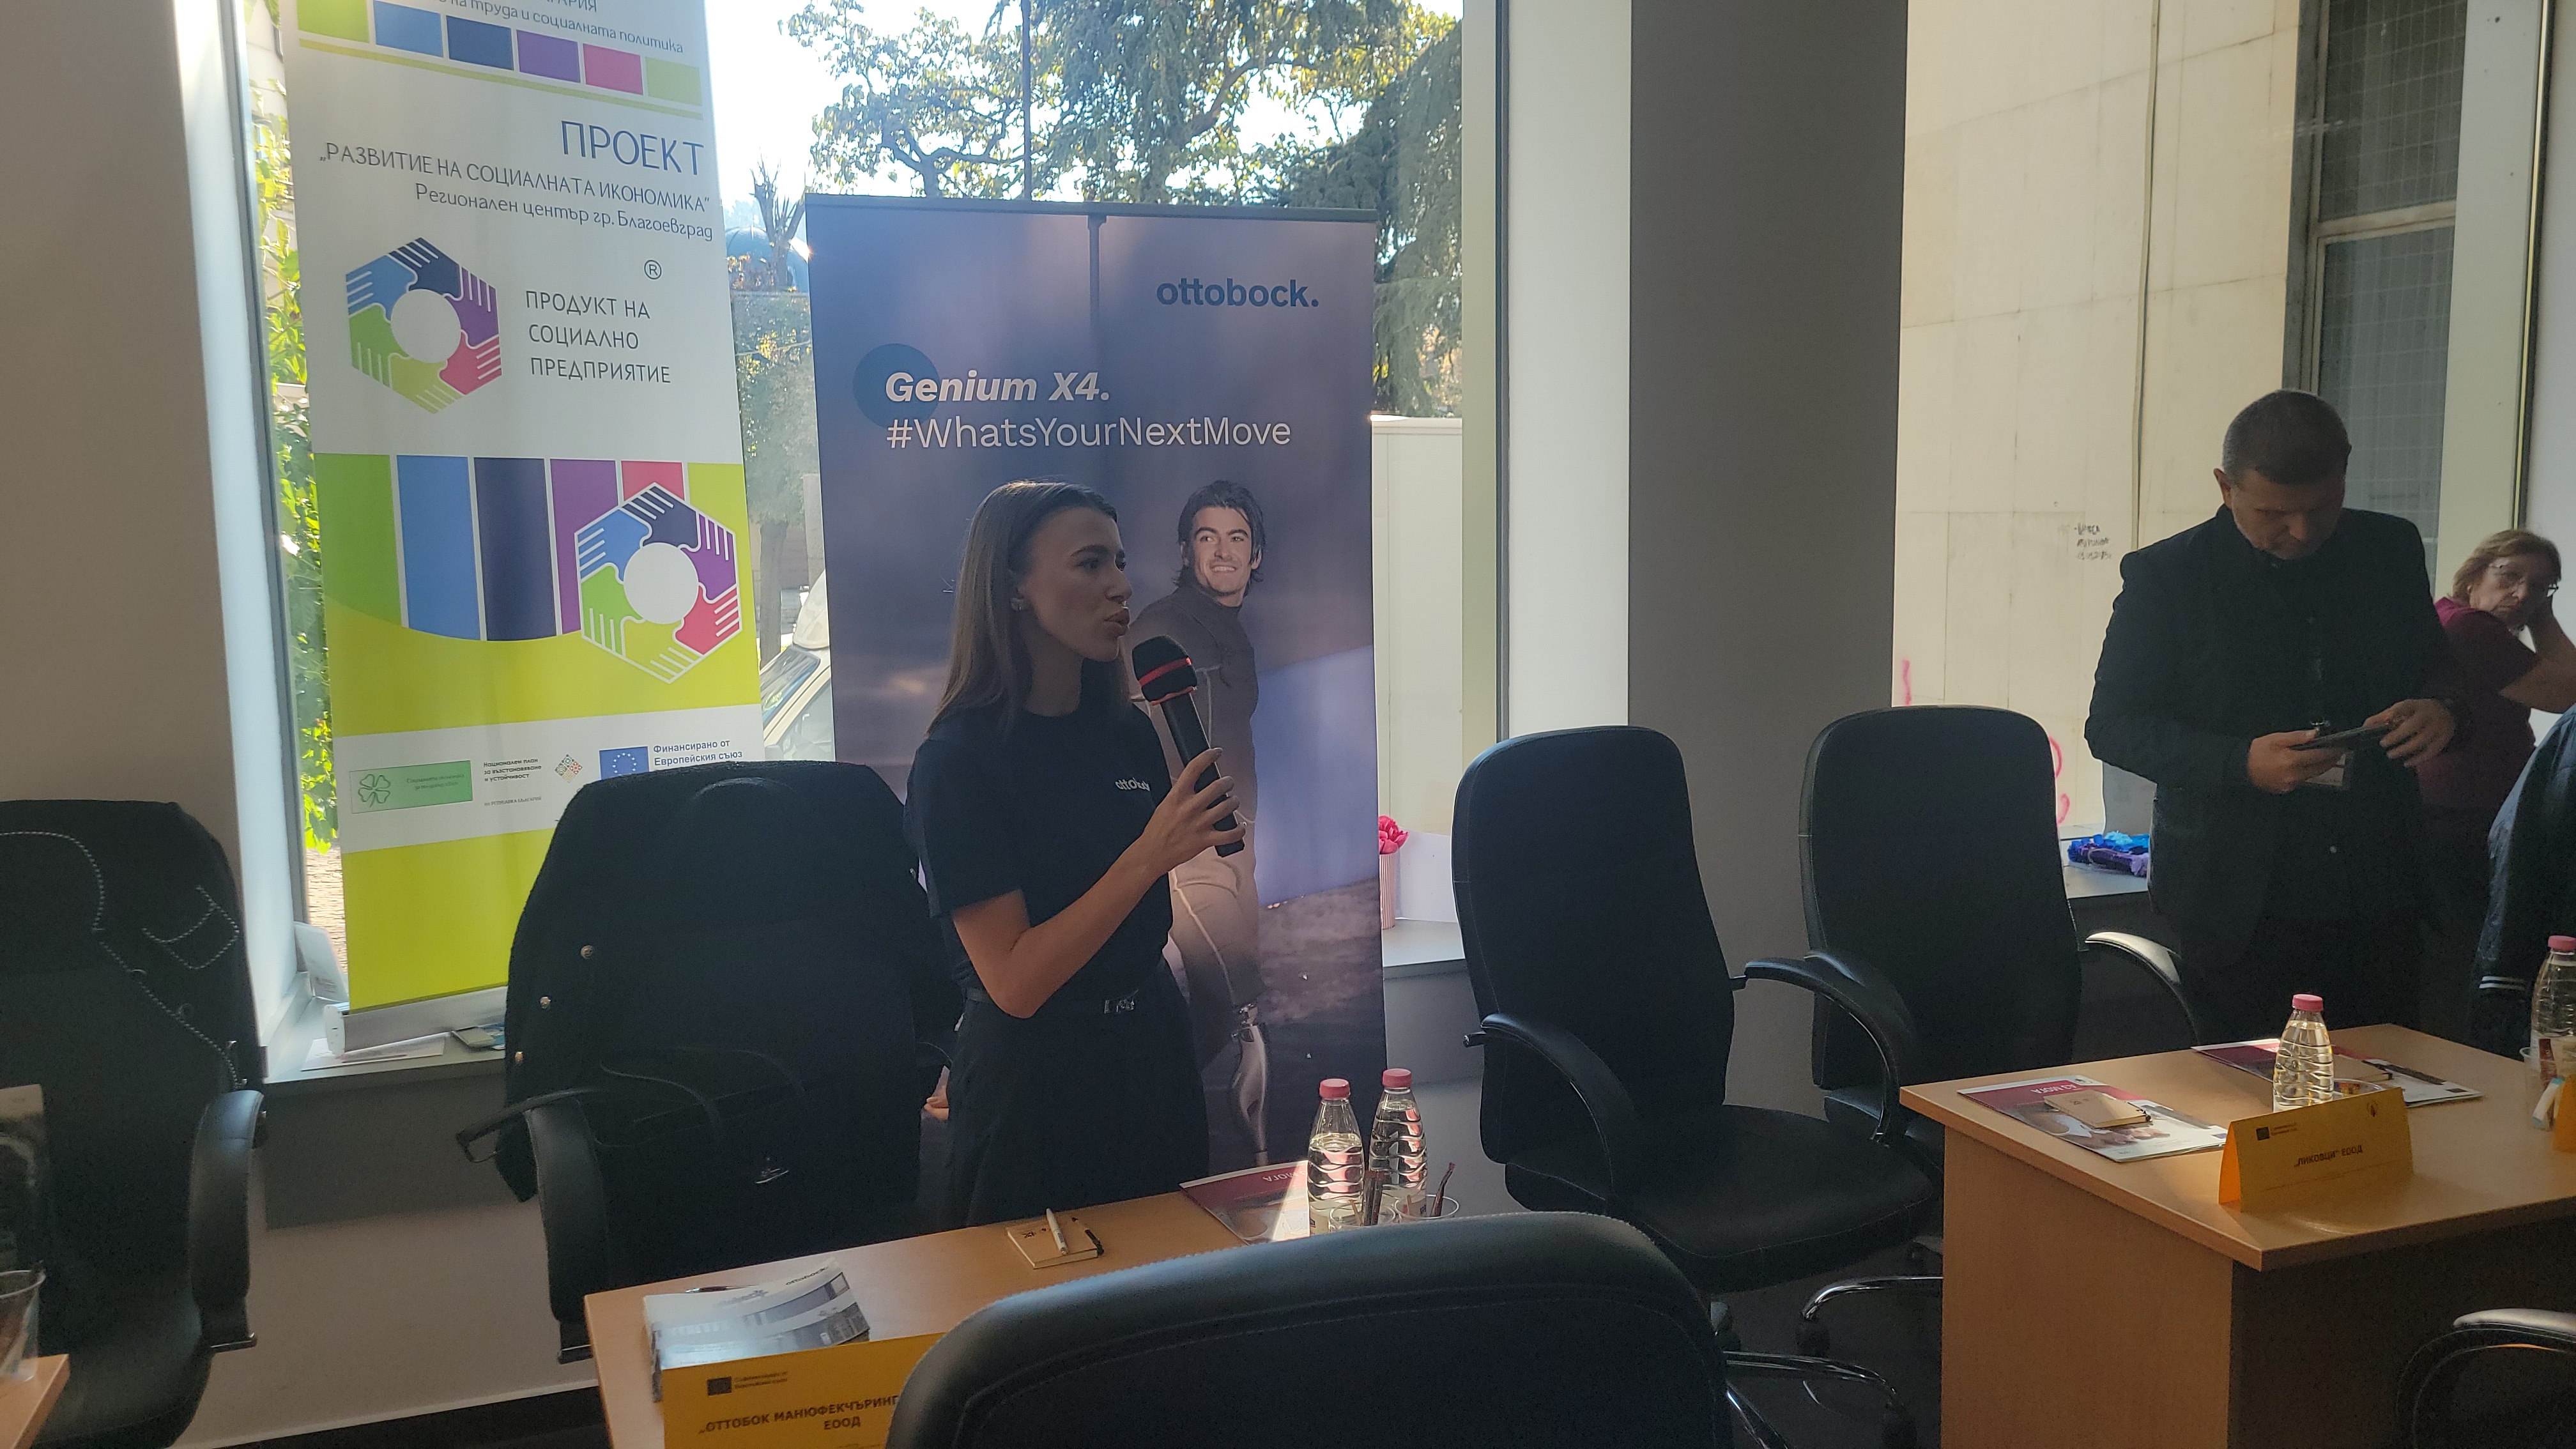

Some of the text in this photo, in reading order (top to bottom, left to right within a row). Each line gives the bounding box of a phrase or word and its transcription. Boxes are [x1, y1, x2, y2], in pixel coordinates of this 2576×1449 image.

[471, 0, 518, 19] труда
[521, 10, 530, 20] и
[533, 12, 617, 39] социалната
[619, 30, 684, 54] политика
[561, 120, 704, 176] ПРОЕКТ
[319, 142, 434, 174] „РАЗВИТИЕ
[437, 158, 462, 180] НА
[466, 163, 595, 197] СОЦИАЛНАТА
[415, 183, 713, 242] Регионален център гр. Благоевград
[526, 290, 650, 319] ПРОДУКТ НА
[1156, 277, 1320, 309] ottobock.
[528, 323, 639, 349] СОЦИАЛНО
[530, 356, 671, 384] ПРЕДПРИЯТИЕ
[885, 369, 1110, 402] Genium X4.
[885, 415, 1291, 448] #WhatsYourNextMove
[654, 739, 730, 753] Финансирано от
[654, 751, 743, 767] Европейския съюз
[824, 1415, 861, 1430] ЕООД
